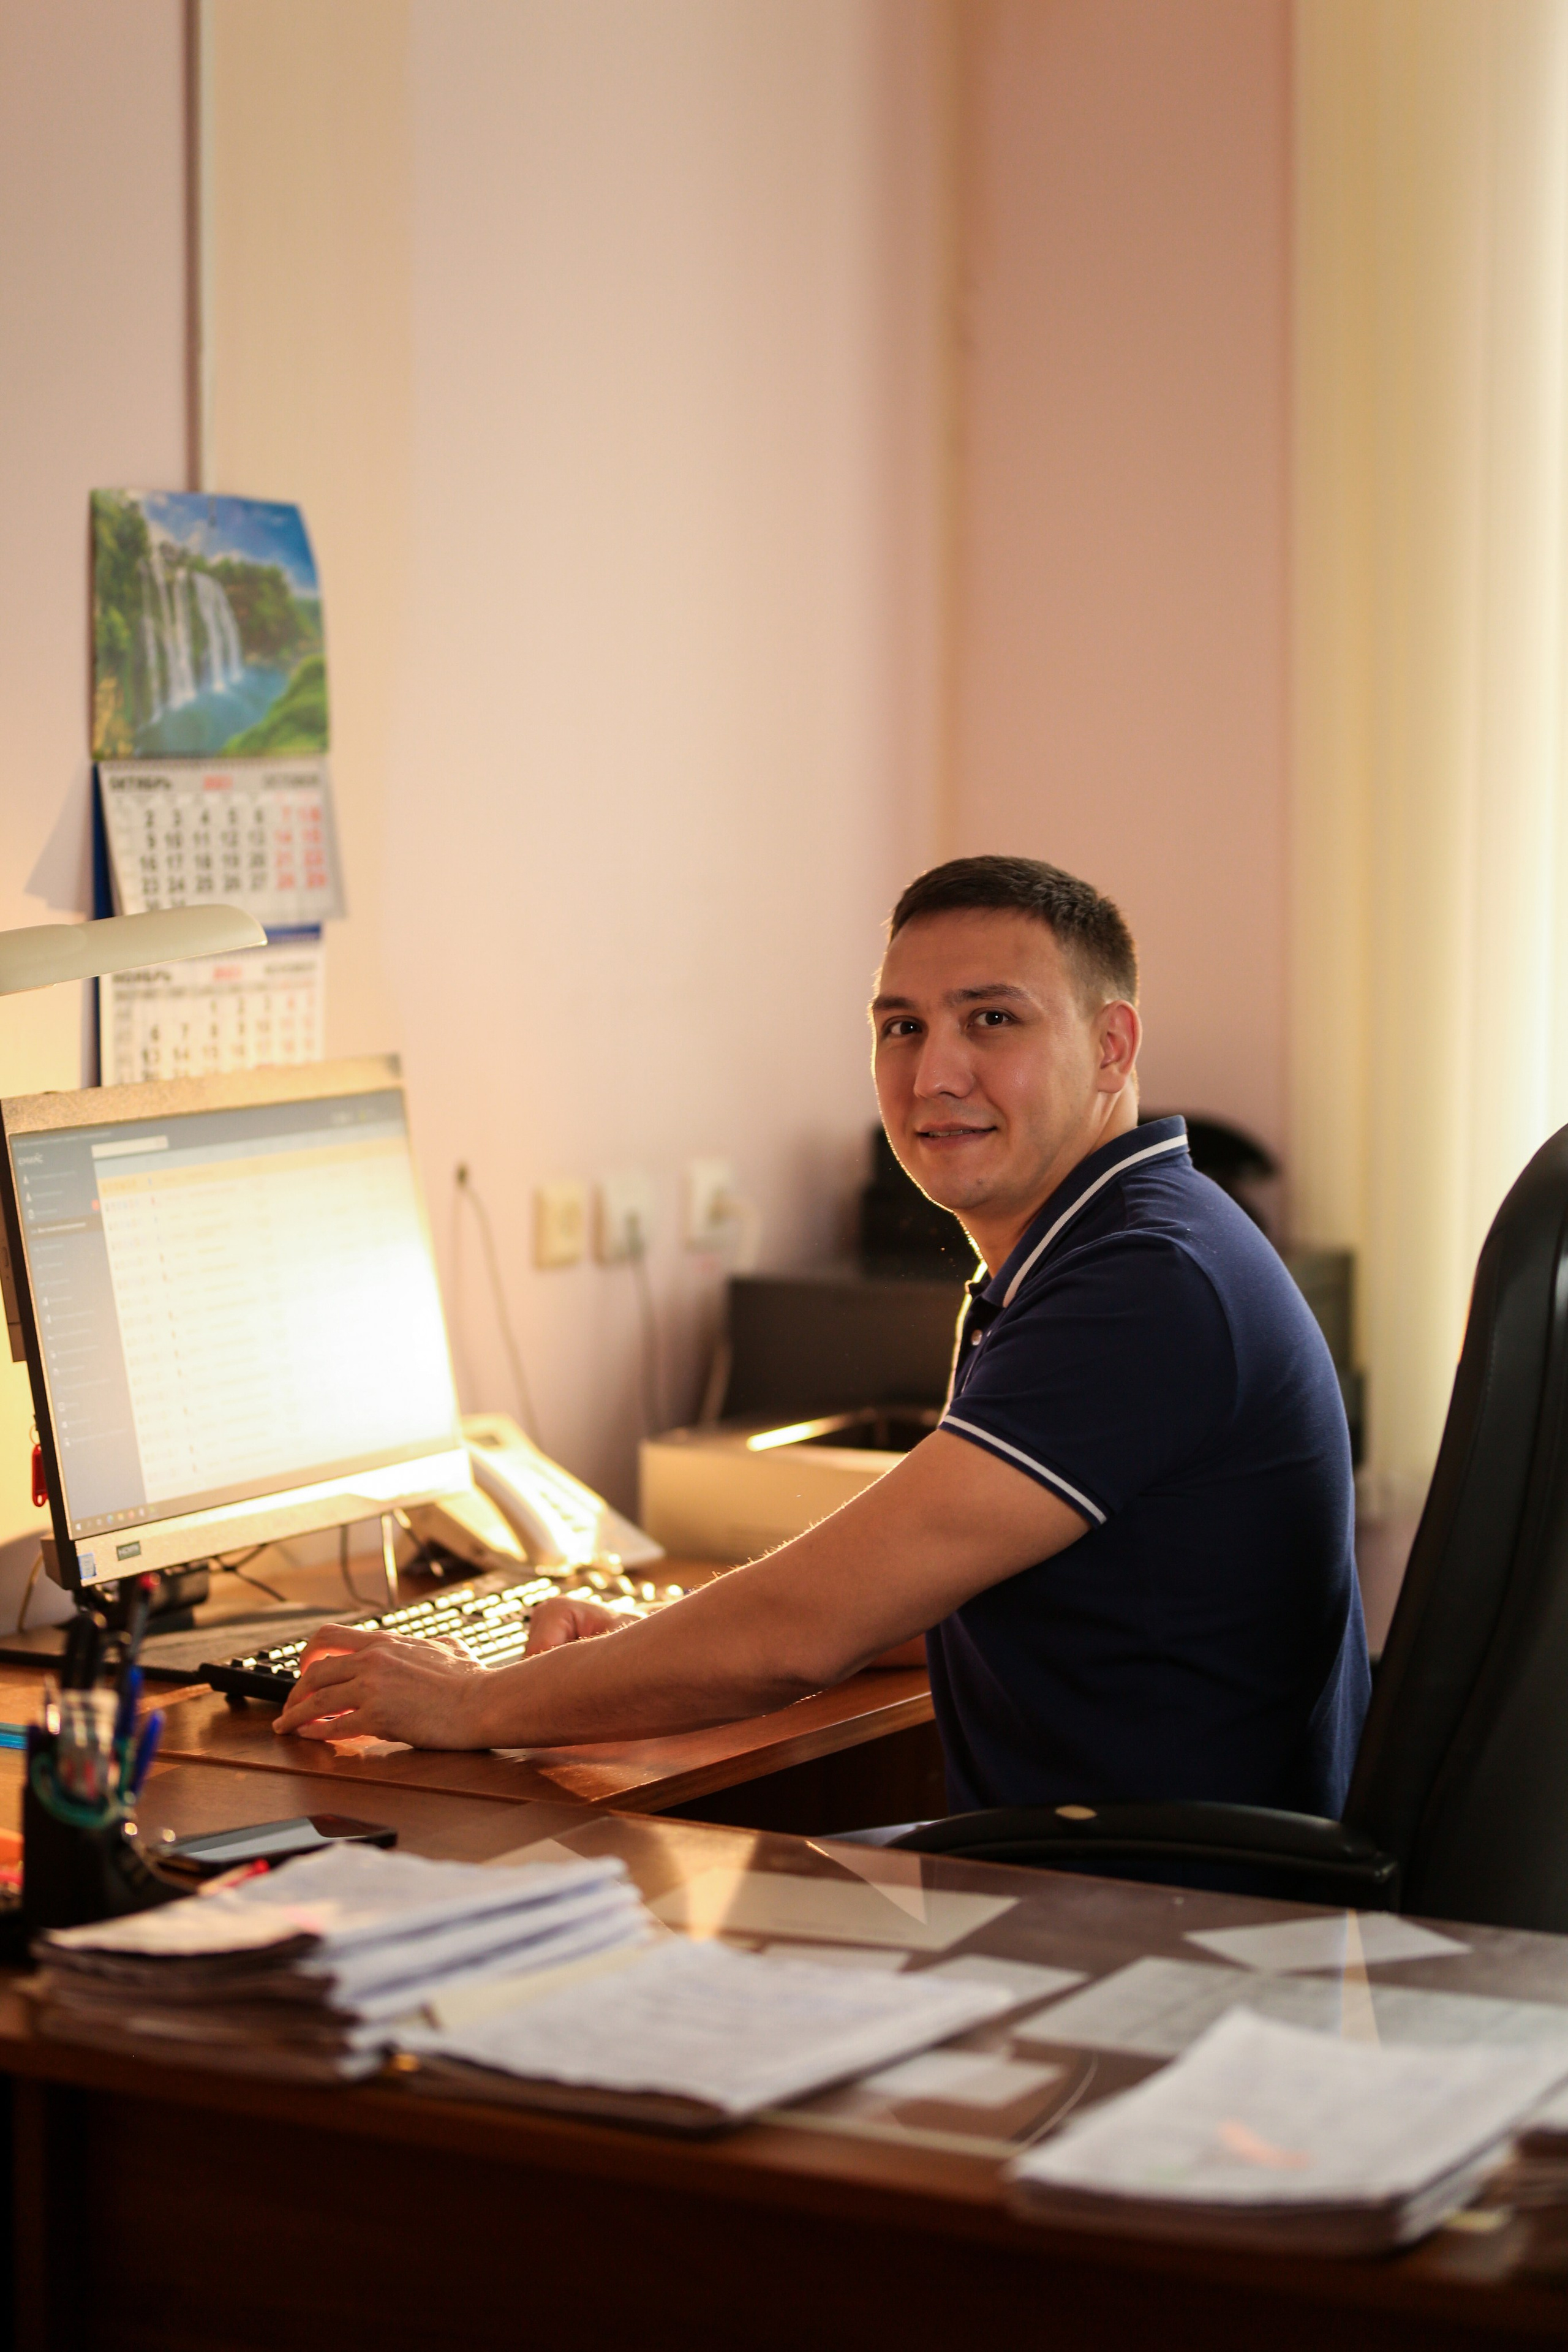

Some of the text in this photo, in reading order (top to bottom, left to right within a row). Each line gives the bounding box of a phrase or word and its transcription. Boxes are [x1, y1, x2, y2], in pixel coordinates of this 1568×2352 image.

[145, 809, 154, 827] 2
[201, 807, 209, 825] 4
[193, 830, 209, 848] 11
[221, 830, 238, 848] 12
[140, 855, 157, 872] 16
[167, 853, 183, 870] 17
[141, 876, 159, 895] 23
[168, 876, 184, 894] 24
